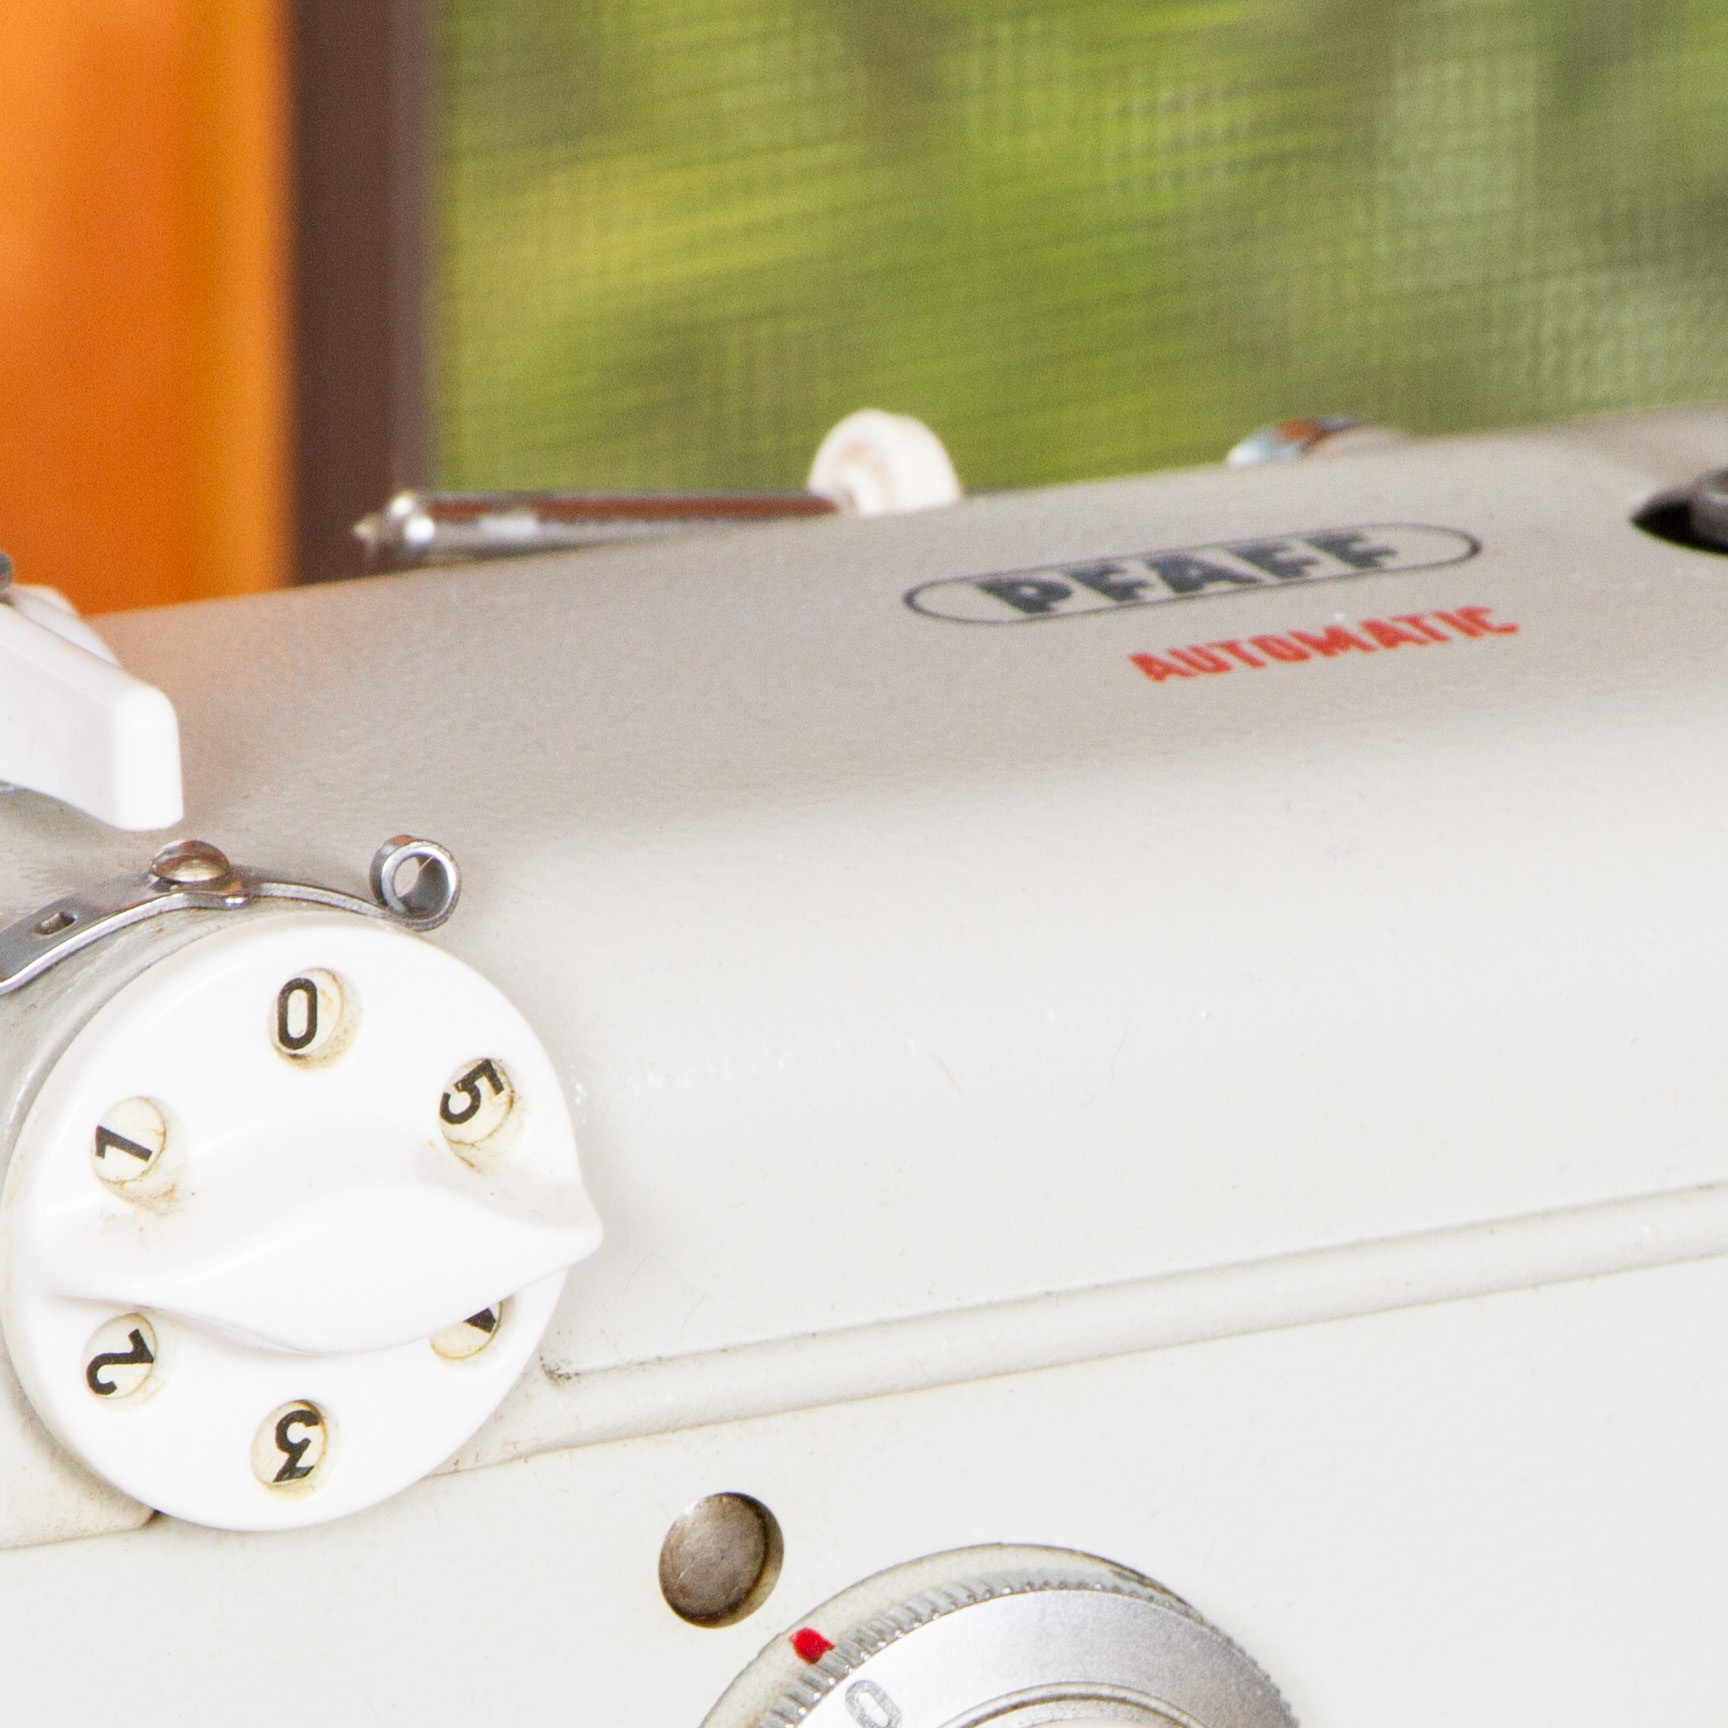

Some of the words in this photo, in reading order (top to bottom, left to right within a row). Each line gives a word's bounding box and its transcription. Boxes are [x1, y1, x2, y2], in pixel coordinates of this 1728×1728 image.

[977, 533, 1398, 615] PFAFF
[1129, 606, 1519, 682] AUTOMATIC
[276, 976, 319, 1052] 0
[439, 1058, 507, 1126] 5
[94, 1124, 154, 1163] 1
[84, 1328, 155, 1397] 2
[272, 1409, 323, 1484] 3
